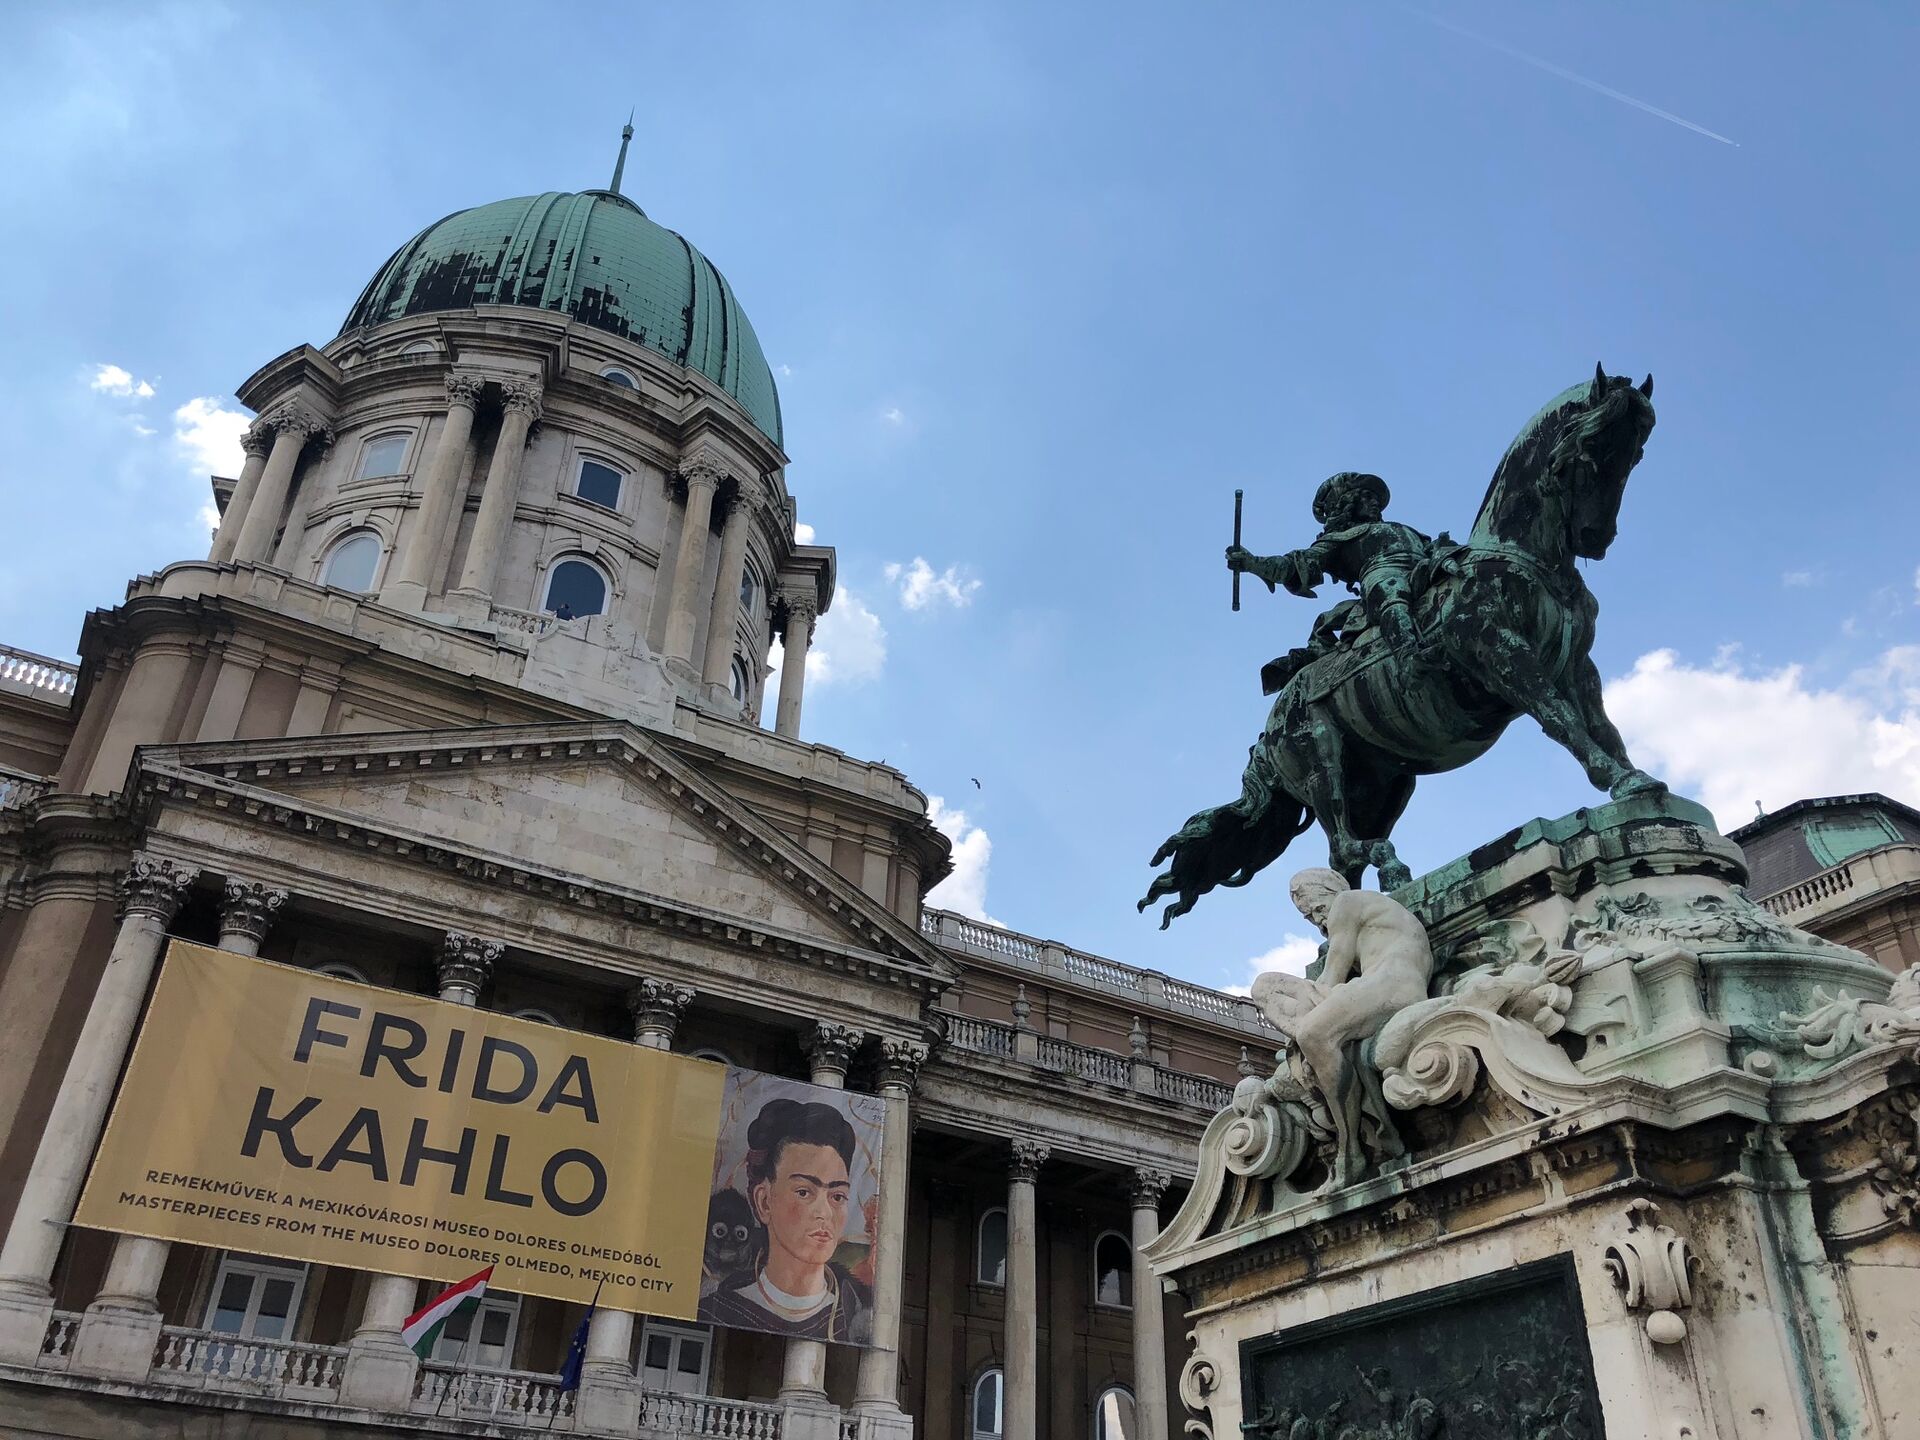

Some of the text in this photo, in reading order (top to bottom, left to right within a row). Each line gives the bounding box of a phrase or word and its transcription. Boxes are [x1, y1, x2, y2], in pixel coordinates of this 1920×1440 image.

[292, 996, 600, 1124] FRIDA
[239, 1085, 608, 1217] KAHLO
[118, 1190, 675, 1294] MASTERPIECES FROM THE MUSEO DOLORES OLMEDO, MEXICO CITY
[146, 1169, 662, 1269] REMEKMŰVEK A MEXIKÓVÁROSI MUSEO DOLORES OLMEDÓBÓL
